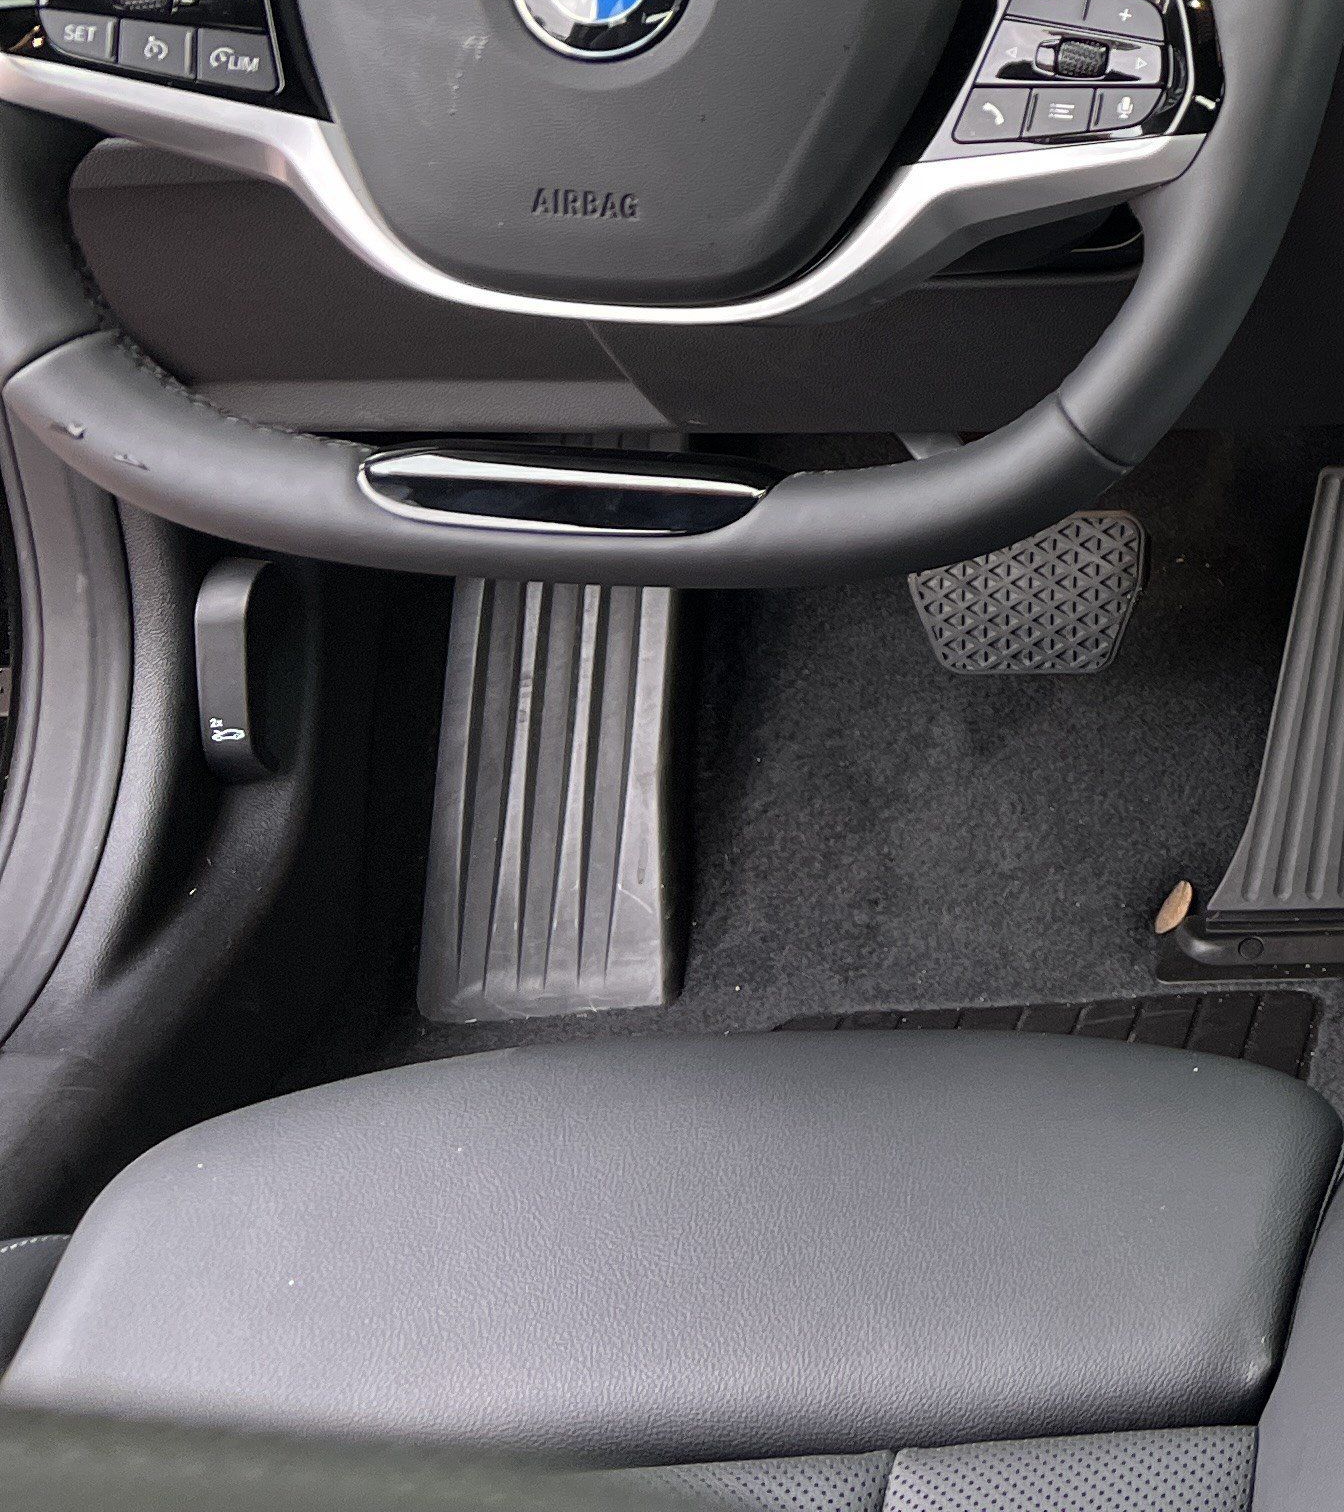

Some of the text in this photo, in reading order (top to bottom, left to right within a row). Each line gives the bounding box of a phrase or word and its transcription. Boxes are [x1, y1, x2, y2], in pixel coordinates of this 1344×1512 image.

[63, 24, 97, 43] SET
[227, 54, 260, 73] LIM
[530, 187, 641, 220] AIRBAG
